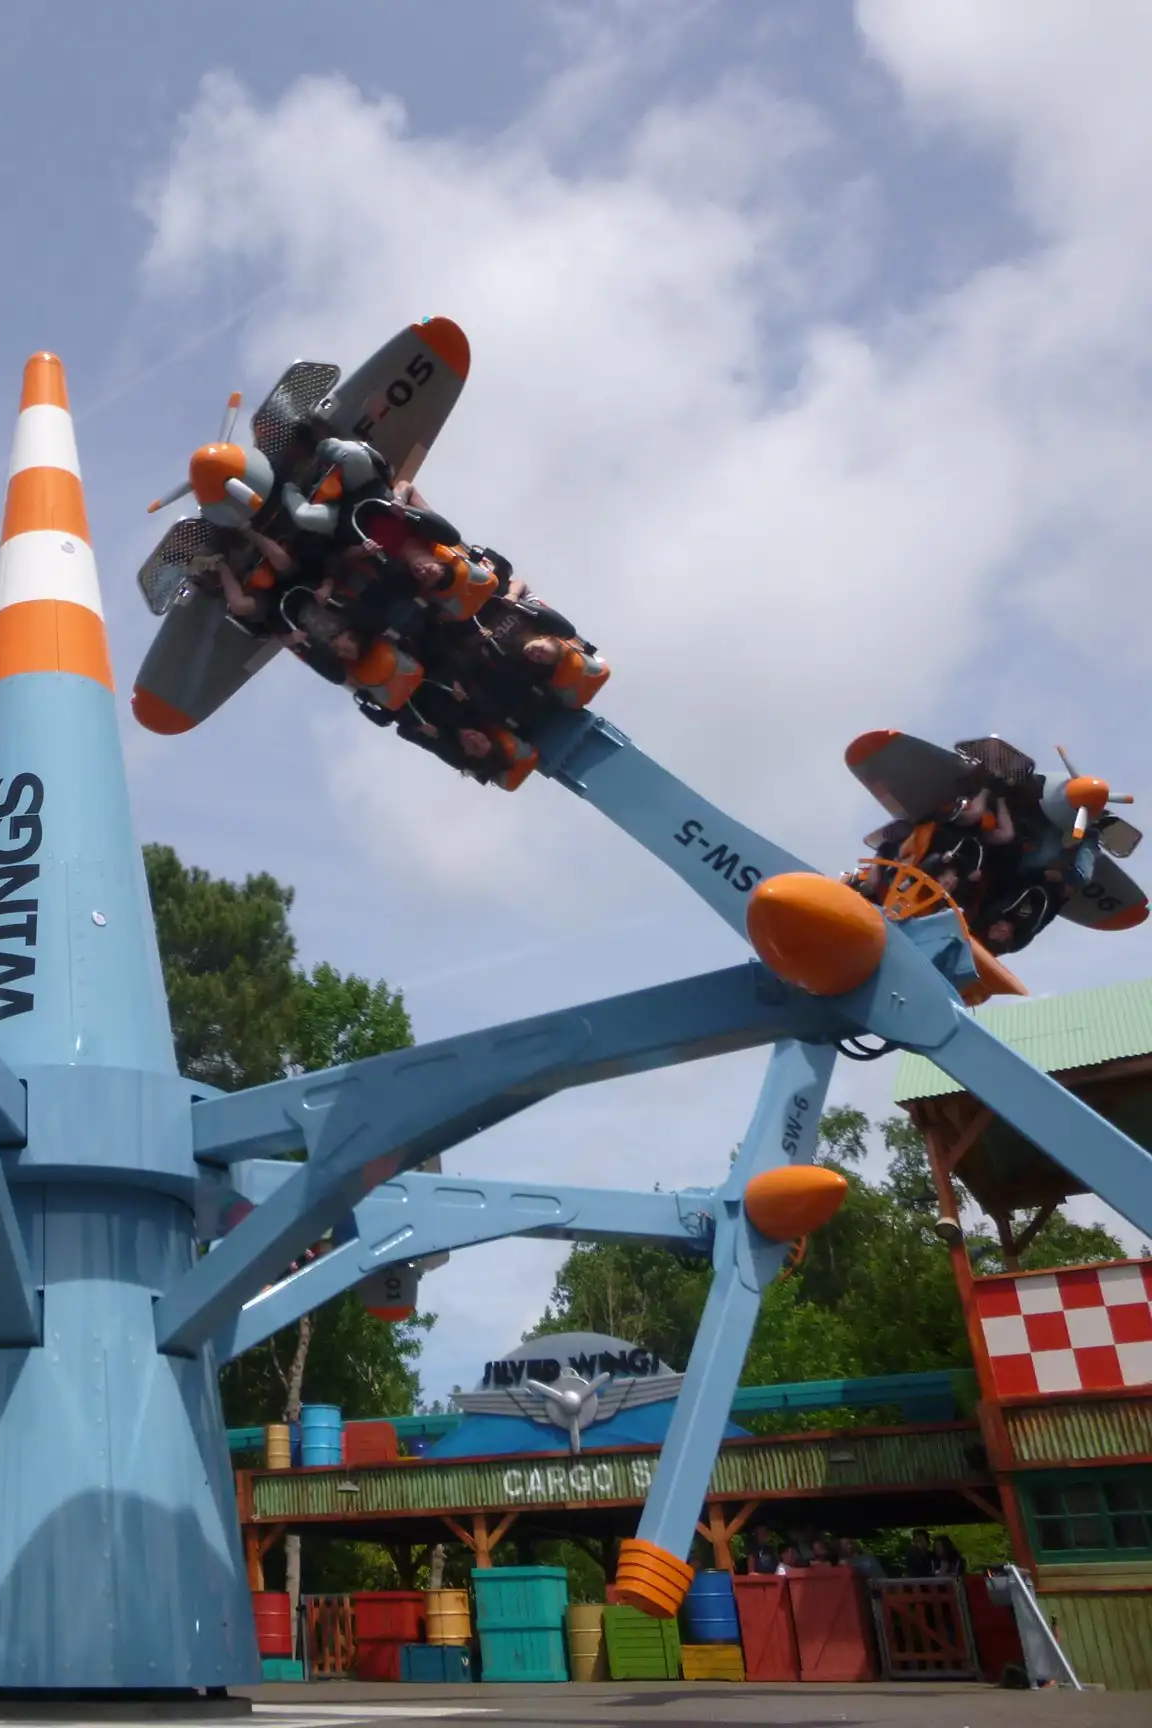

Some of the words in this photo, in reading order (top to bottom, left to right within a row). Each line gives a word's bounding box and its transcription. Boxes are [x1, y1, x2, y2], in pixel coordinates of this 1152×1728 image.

[352, 353, 434, 441] F-05
[673, 819, 762, 892] SW-5
[782, 1093, 809, 1157] SW-6
[503, 1462, 614, 1497] CARGO
[631, 1458, 659, 1489] S
